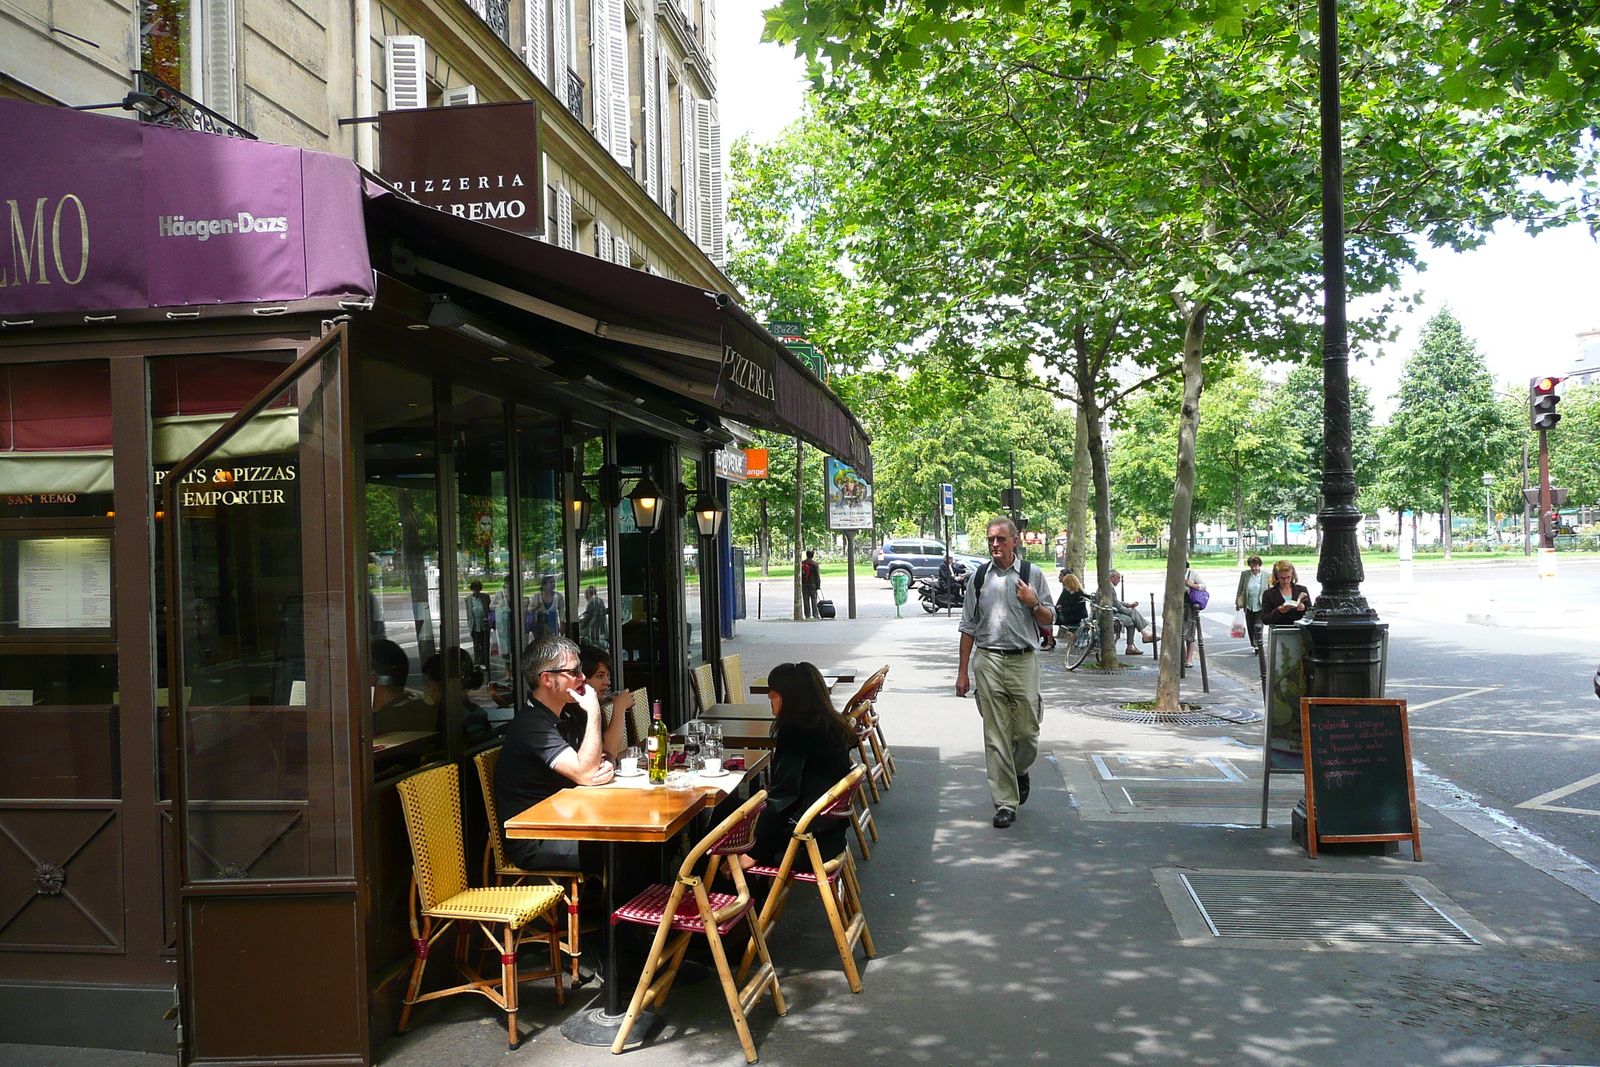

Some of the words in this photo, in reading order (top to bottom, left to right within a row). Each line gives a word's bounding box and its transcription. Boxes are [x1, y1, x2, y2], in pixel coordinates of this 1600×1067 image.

[393, 174, 524, 193] PIZZERIA
[450, 199, 526, 220] REMO
[159, 212, 288, 241] Häagen-Dazs
[0, 193, 89, 287] MO
[723, 344, 776, 401] PIZZERIA
[154, 469, 207, 485] PTS
[212, 468, 228, 483] &
[232, 465, 296, 482] PIZZAS
[746, 468, 765, 477] ange
[8, 494, 33, 505] SAN
[40, 493, 77, 504] REMO
[183, 489, 285, 507] EMPORTER
